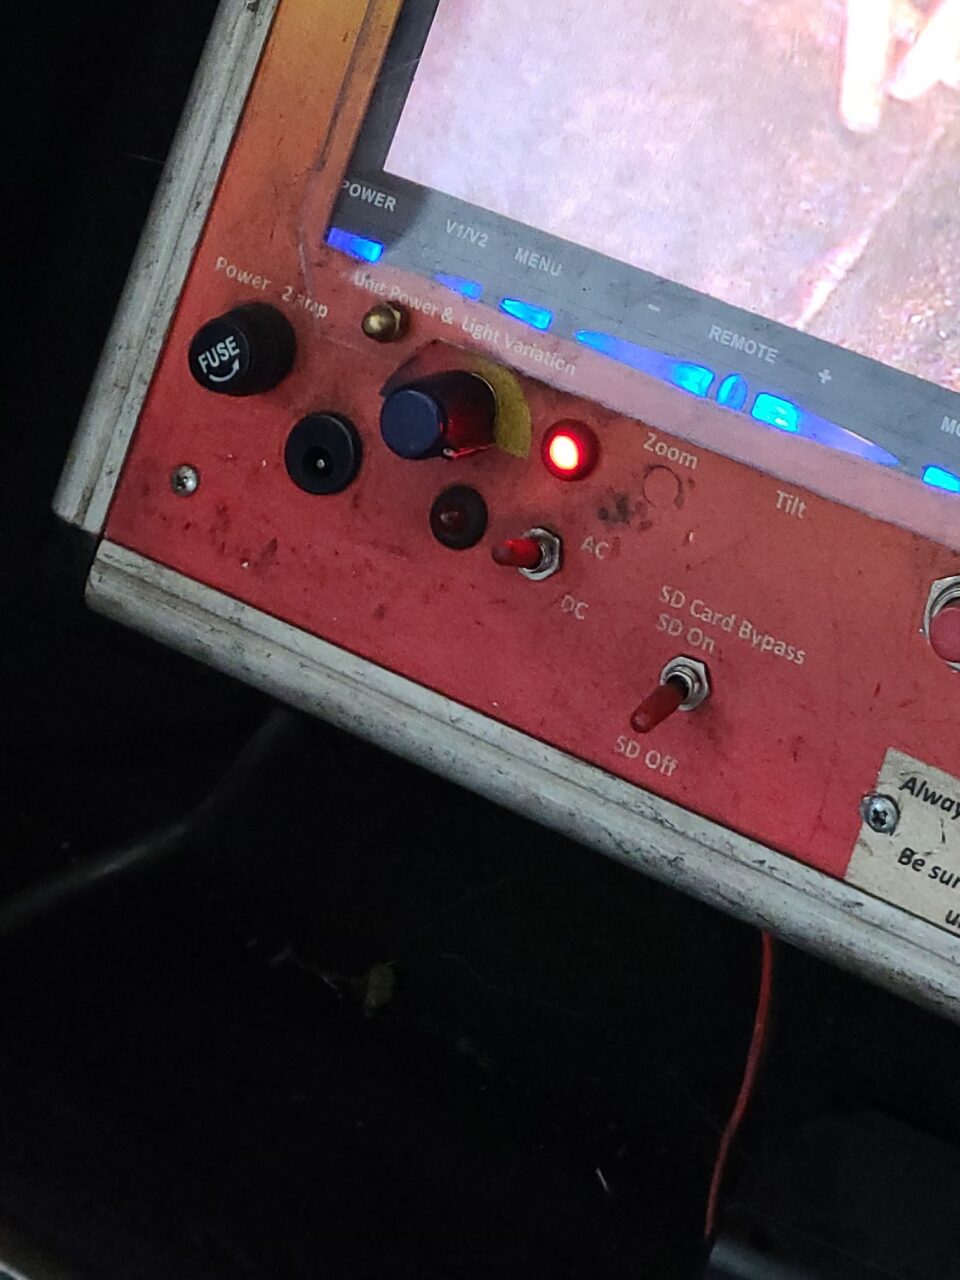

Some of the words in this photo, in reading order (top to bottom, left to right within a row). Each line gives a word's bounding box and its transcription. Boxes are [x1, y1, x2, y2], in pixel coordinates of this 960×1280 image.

[446, 219, 488, 248] V1/V2
[216, 256, 272, 292] Power
[282, 285, 295, 302] 2
[513, 247, 563, 277] MENU
[389, 288, 438, 317] Power
[440, 307, 453, 324] &
[461, 316, 500, 342] Light
[504, 334, 576, 375] Variation
[708, 324, 779, 365] REMOTE
[199, 334, 241, 374] FUSE
[643, 432, 699, 470] Zoom
[775, 490, 807, 518] Tilt
[581, 536, 609, 559] AC
[560, 595, 589, 620] DC
[660, 585, 687, 608] SD
[691, 596, 737, 633] Card
[739, 617, 806, 666] Bypass
[655, 614, 683, 637] SD
[685, 628, 716, 654] On
[615, 735, 641, 756] SD
[644, 746, 680, 777] Off
[898, 847, 926, 874] Be
